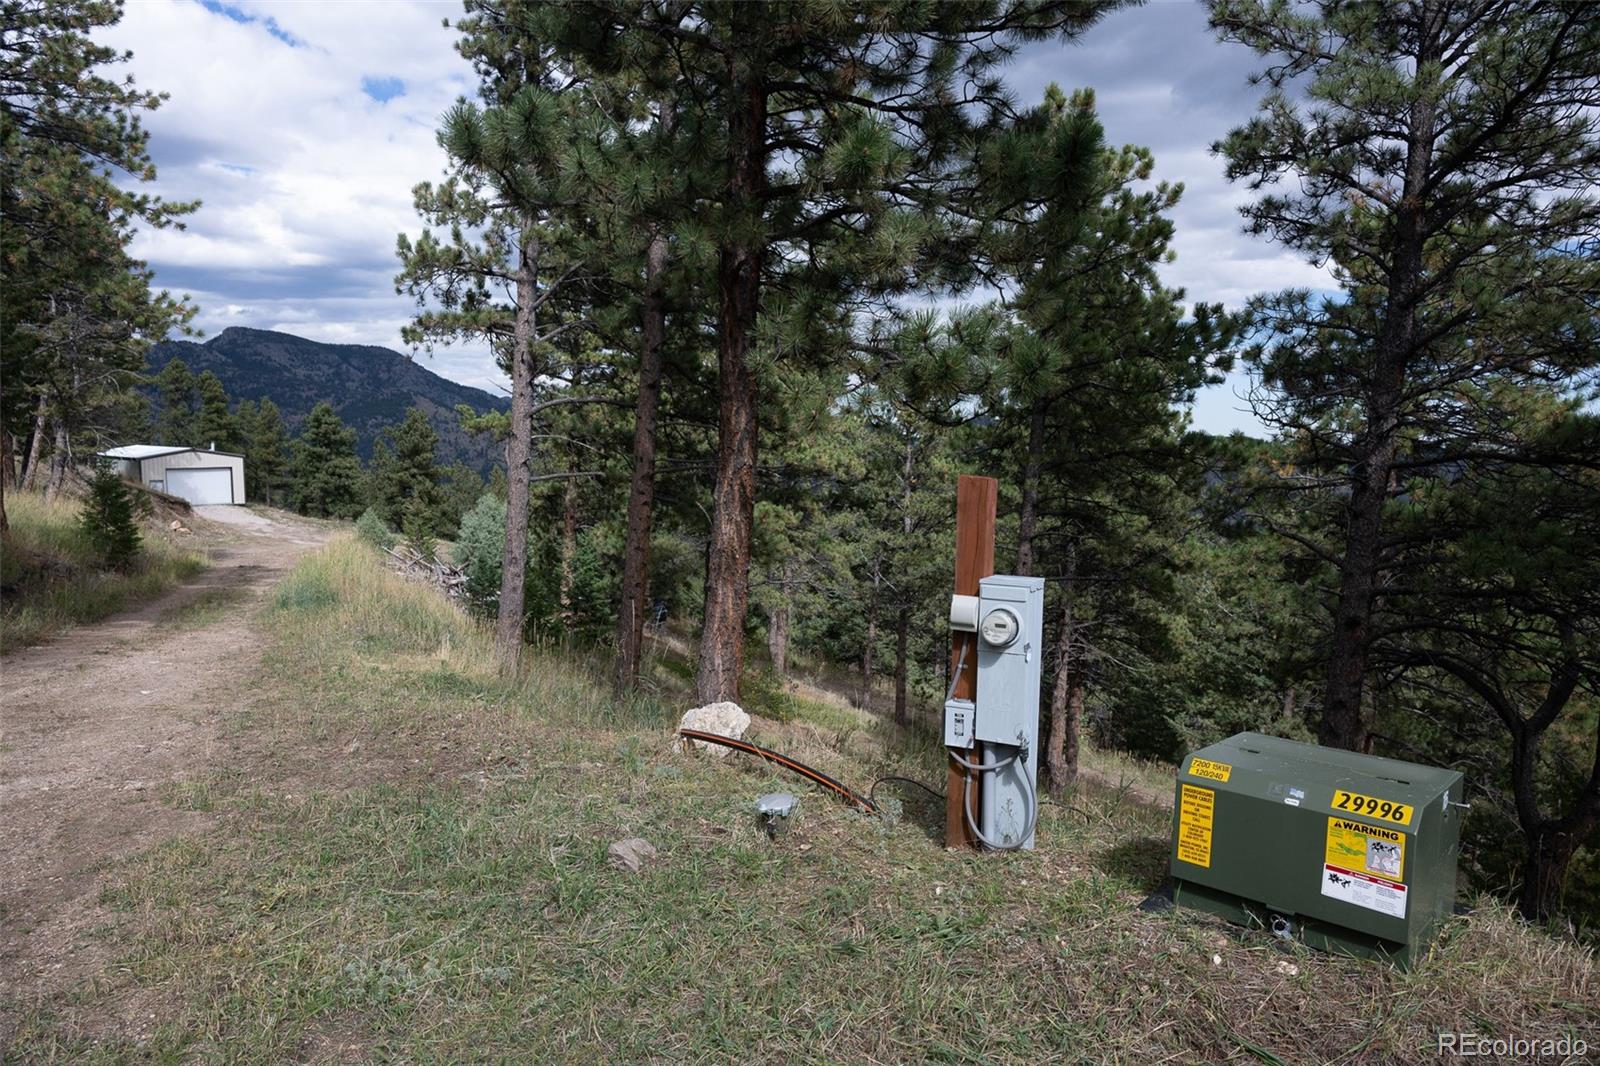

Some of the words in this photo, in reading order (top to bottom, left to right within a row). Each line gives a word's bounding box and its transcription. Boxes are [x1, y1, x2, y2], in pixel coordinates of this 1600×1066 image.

[1193, 760, 1211, 769] 7200
[1195, 769, 1224, 780] 120/240
[1337, 793, 1404, 821] 29996
[1343, 821, 1399, 841] WARNING
